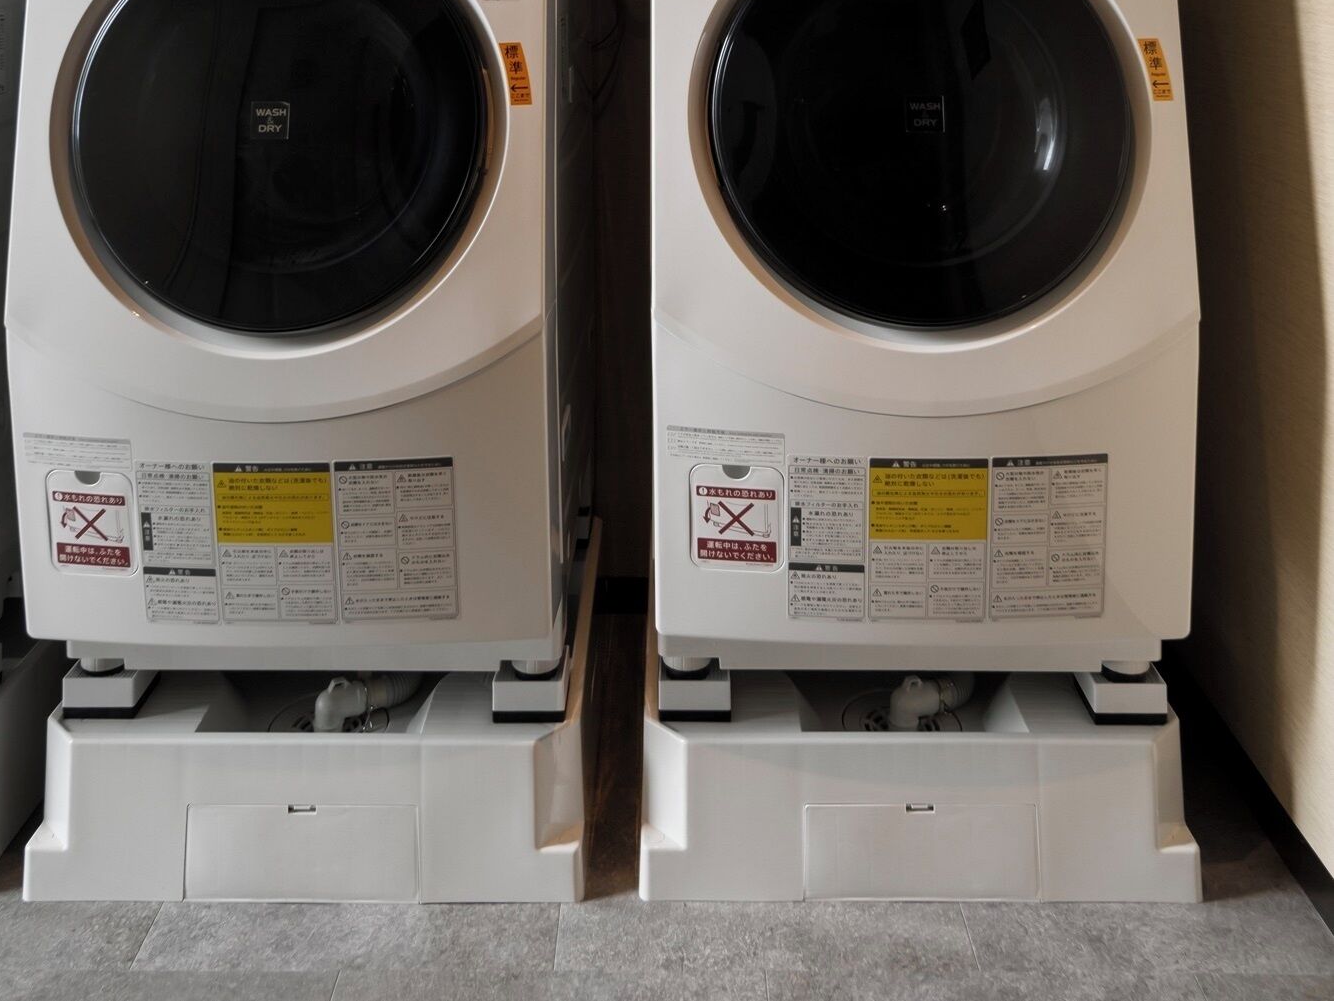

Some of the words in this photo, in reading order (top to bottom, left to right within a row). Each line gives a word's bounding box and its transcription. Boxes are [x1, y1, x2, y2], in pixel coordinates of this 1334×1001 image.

[909, 102, 940, 111] WASH
[256, 108, 286, 117] WASH
[913, 118, 937, 127] DRY
[258, 125, 282, 133] DRY
[793, 457, 862, 466] オーナー様へのお願い
[708, 488, 773, 500] 水もれの恐れあり
[700, 549, 775, 561] 開けないでください。
